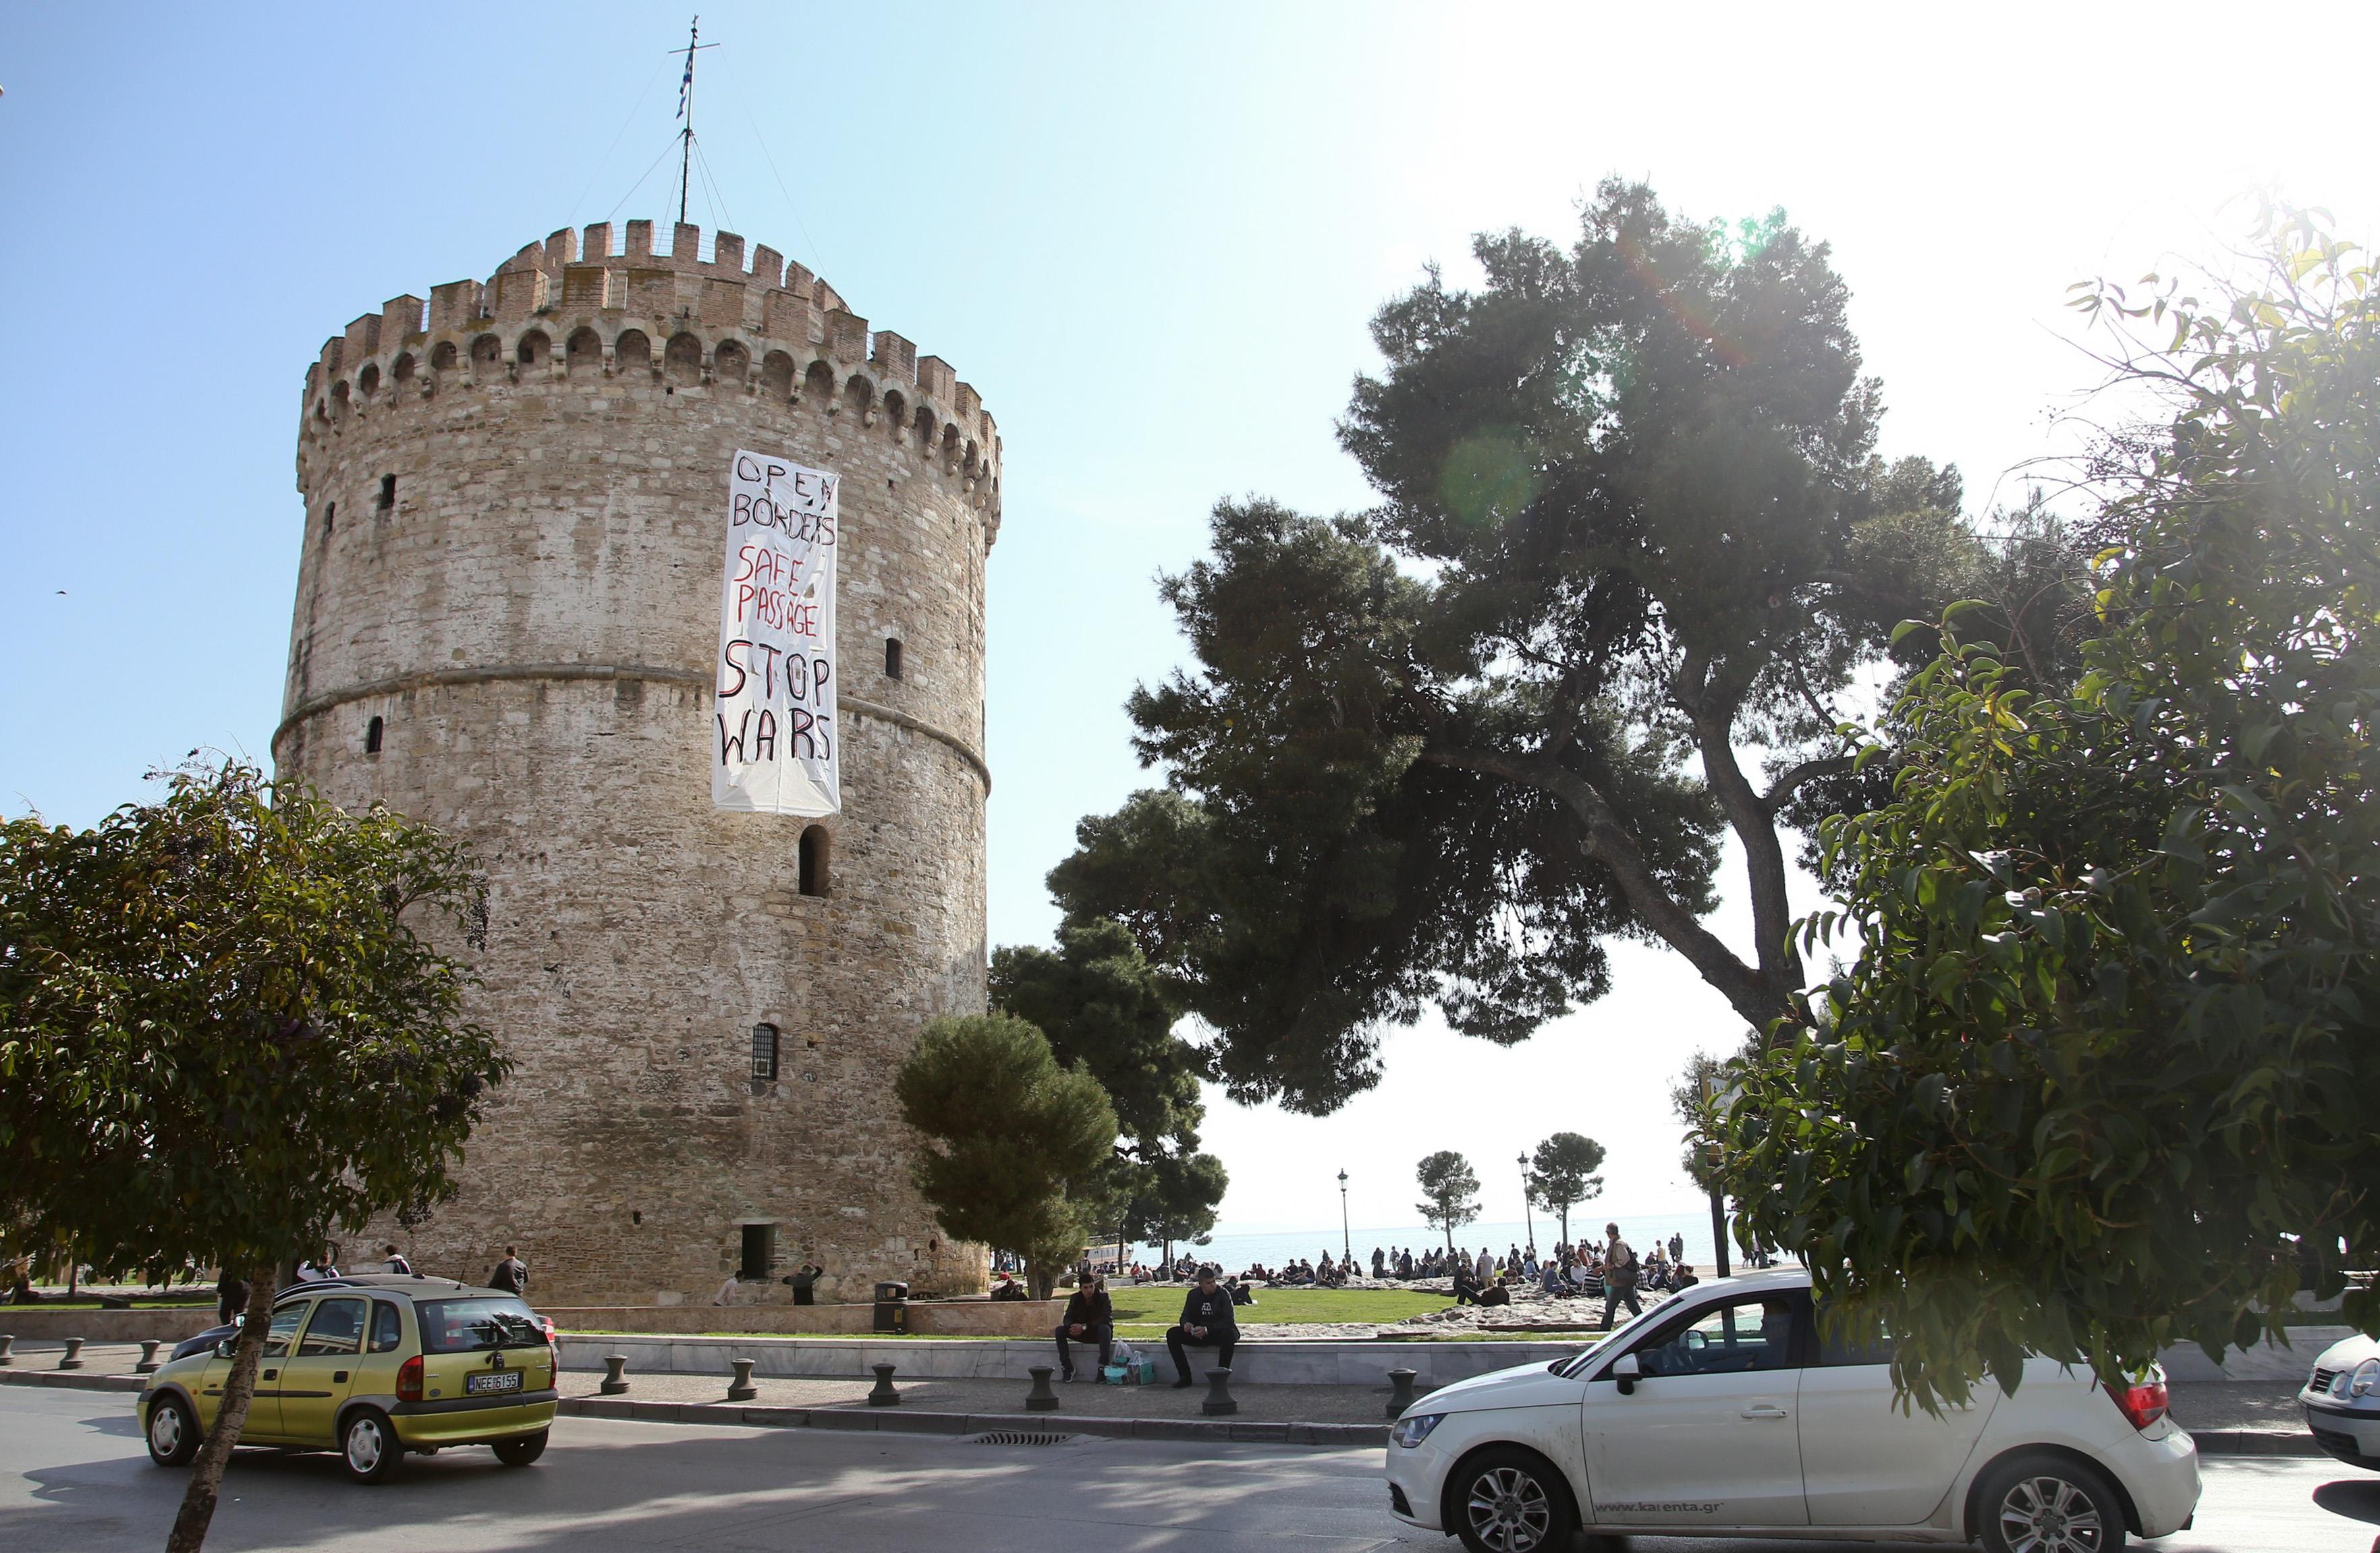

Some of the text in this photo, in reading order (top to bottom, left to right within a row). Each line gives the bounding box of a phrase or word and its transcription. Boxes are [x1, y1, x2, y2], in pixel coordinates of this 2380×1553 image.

[738, 456, 837, 503] OPEN
[734, 494, 835, 545] BORDERS
[734, 546, 804, 596] SAFE
[738, 584, 819, 638] PASSAGE
[719, 640, 830, 707] STOP
[717, 708, 830, 766] WARS
